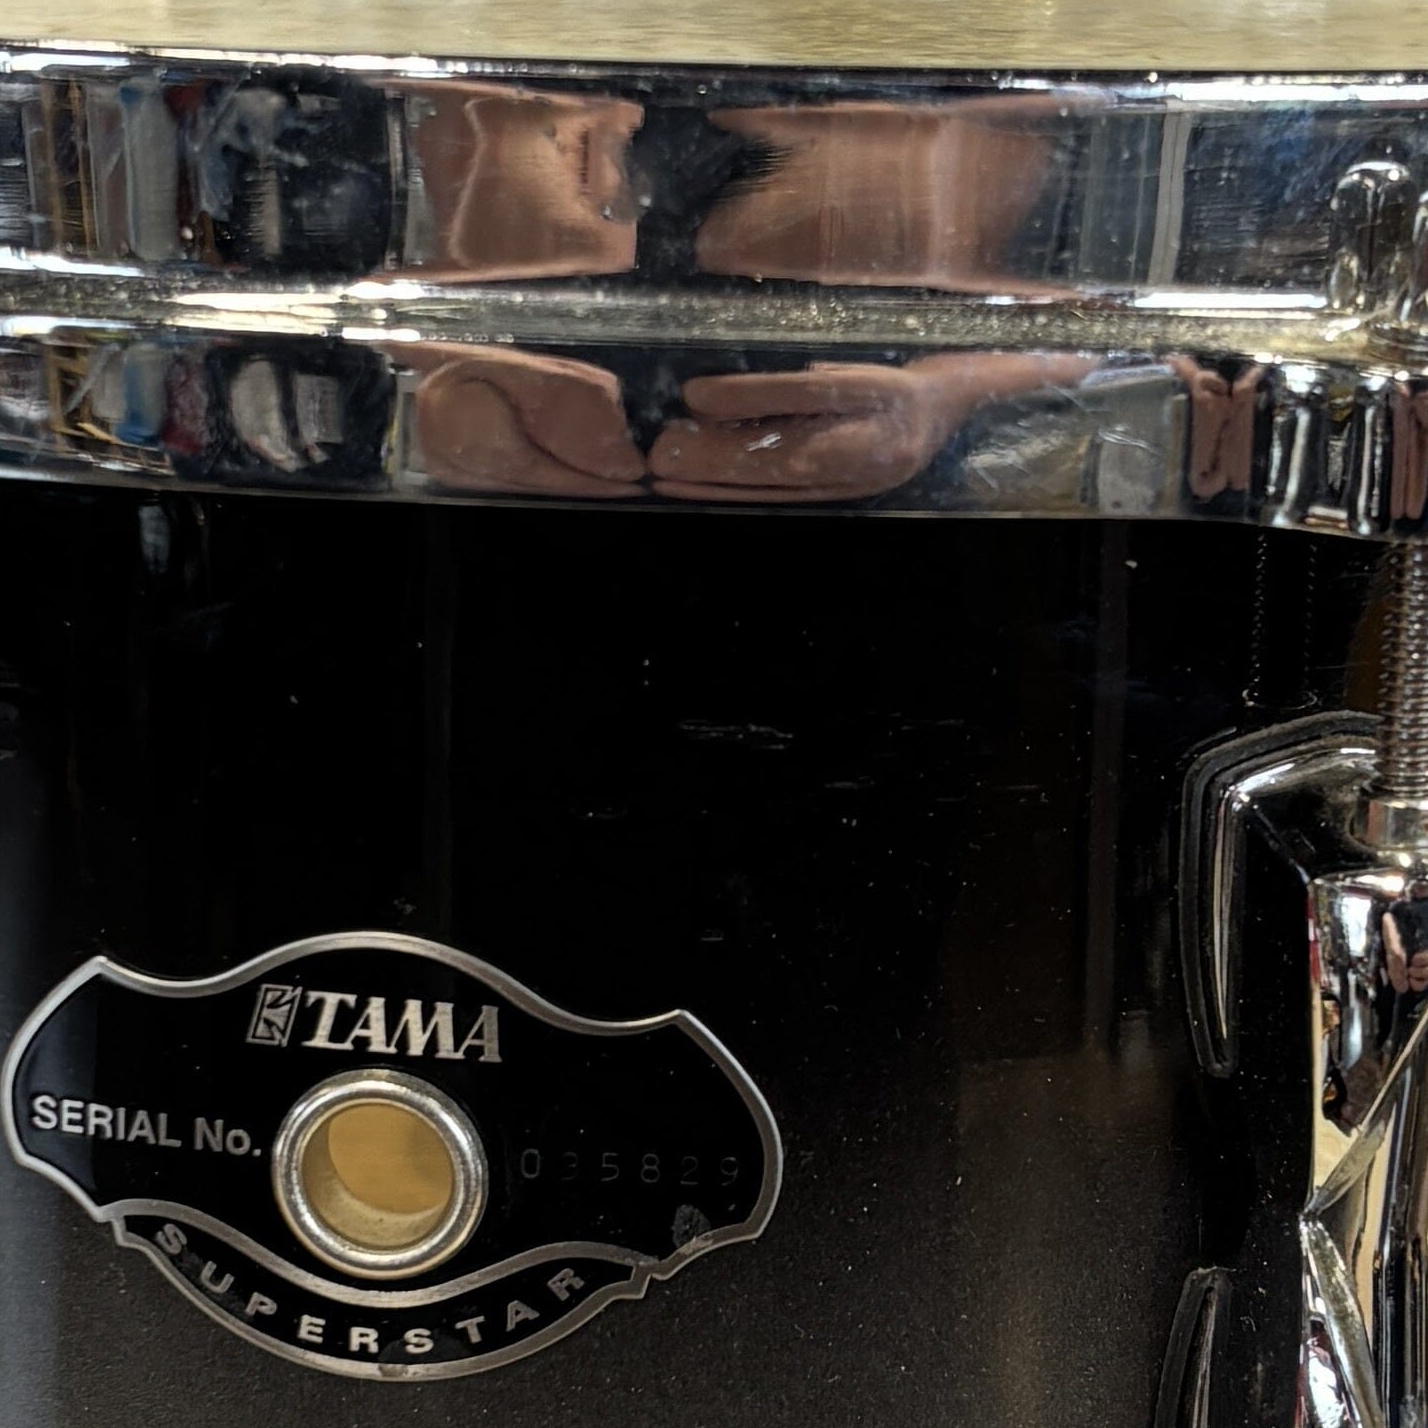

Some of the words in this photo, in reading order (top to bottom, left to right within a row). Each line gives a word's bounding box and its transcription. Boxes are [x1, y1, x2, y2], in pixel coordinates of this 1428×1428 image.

[302, 989, 503, 1063] TAMA
[31, 1093, 182, 1150] SERIAL
[193, 1118, 262, 1158] No.
[519, 1147, 740, 1187] 035829
[155, 1222, 587, 1356] SUPERSTAR
